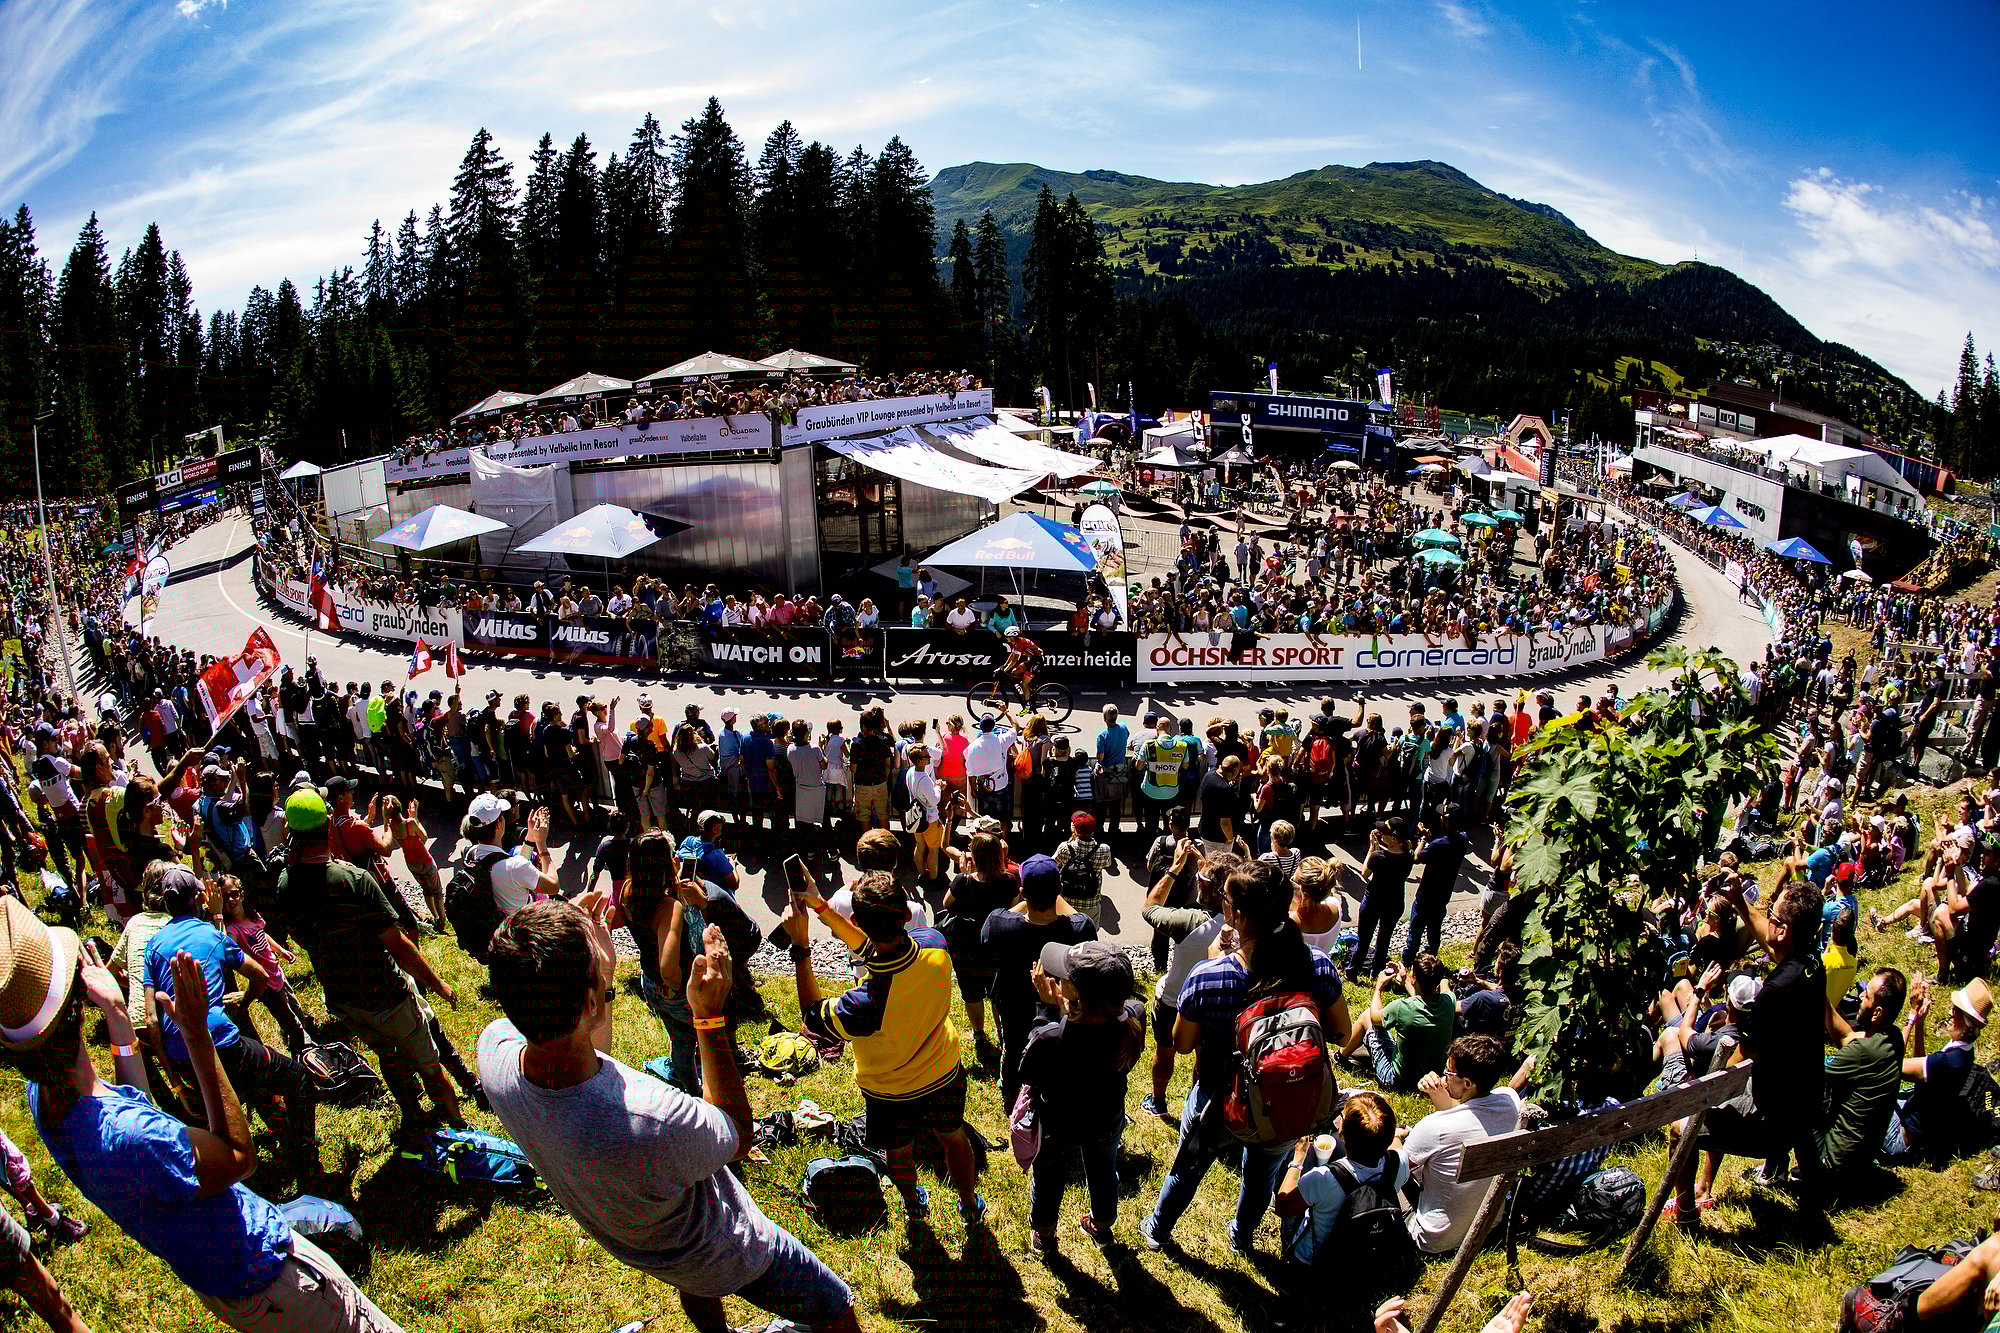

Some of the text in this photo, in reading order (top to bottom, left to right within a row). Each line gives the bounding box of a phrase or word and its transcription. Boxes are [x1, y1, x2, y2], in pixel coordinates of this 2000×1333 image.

[805, 416, 855, 431] Graubünden
[856, 412, 869, 424] VIP
[871, 411, 896, 422] Lounge
[896, 404, 926, 420] presented
[926, 403, 935, 415] by
[935, 400, 957, 413] Valbella
[957, 400, 966, 410] Inn
[966, 399, 981, 409] Resort
[1268, 403, 1349, 421] SHIMANO
[508, 446, 538, 460] presented
[539, 445, 548, 456] by
[549, 441, 578, 454] Valbella
[580, 441, 592, 451] Inn
[594, 437, 619, 449] Resort
[183, 463, 207, 475] MOUNTAIN
[228, 460, 252, 473] FINISH
[446, 455, 470, 467] Graubünd
[1540, 452, 1550, 485] CHOPFAB
[160, 472, 180, 487] UCI
[183, 468, 210, 480] WORLD CUP
[126, 490, 148, 505] FINISH
[975, 550, 1035, 561] Red Bull
[473, 618, 537, 641] Mitas
[551, 625, 610, 644] Mitas
[711, 642, 821, 664] WATCH ON
[890, 643, 992, 667] Arosa
[1043, 650, 1132, 667] nzerheide
[1271, 647, 1344, 665] SPORT
[1356, 648, 1514, 668] cornercard
